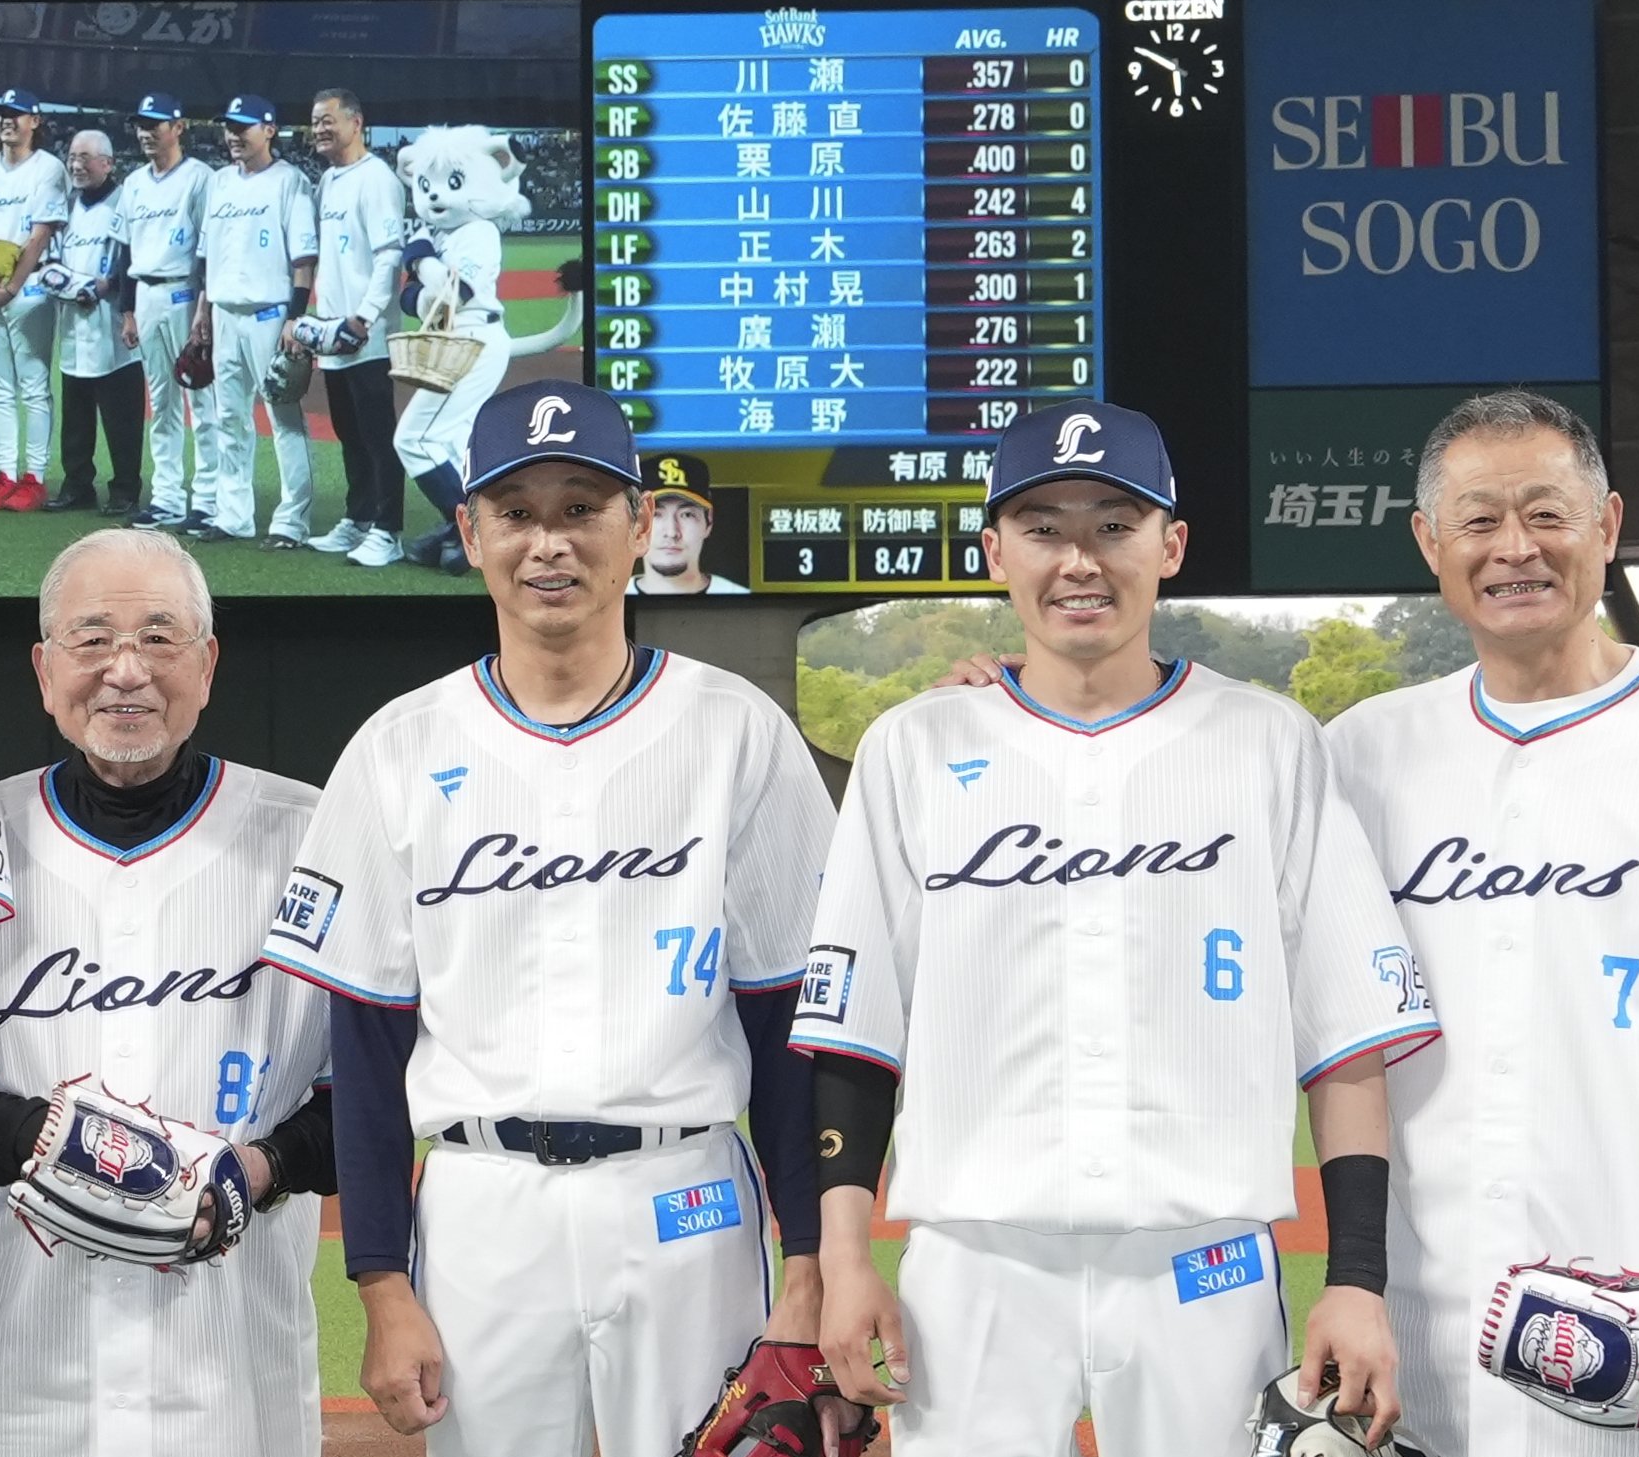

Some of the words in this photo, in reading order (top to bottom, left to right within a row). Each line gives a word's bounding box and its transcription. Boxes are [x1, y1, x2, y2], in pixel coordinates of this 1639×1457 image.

[764, 7, 818, 25] SoftBank
[1166, 22, 1185, 41] 12
[759, 23, 826, 48] HAWKS
[955, 27, 1008, 50] AVG.
[1047, 29, 1079, 45] HR
[609, 65, 637, 94] SS
[967, 60, 1014, 88] .357
[609, 107, 636, 136] RF
[718, 101, 862, 137] 佐藤直
[967, 103, 1015, 131] .278
[1169, 98, 1184, 118] 6
[1273, 91, 1568, 171] SEIBU
[609, 150, 639, 179] 3B
[737, 142, 844, 178] 栗原
[968, 145, 1015, 173] .400
[609, 193, 639, 222] DH
[738, 186, 843, 221] 山川
[968, 188, 1015, 215] .242
[611, 235, 637, 264] LF
[738, 228, 844, 263] 正木
[968, 231, 1016, 258] .263
[1302, 198, 1540, 276] SOGO
[613, 277, 640, 306] 1B
[720, 271, 863, 306] 中村晃
[969, 274, 1016, 301] .300
[610, 319, 640, 349] 2B
[969, 317, 1017, 344] .276
[611, 361, 638, 390] CF
[719, 354, 864, 390] 牧原大
[970, 358, 1017, 386] .222
[739, 398, 846, 433] 海野
[889, 451, 947, 482] 有原
[962, 450, 996, 480] 航
[770, 508, 842, 533] 登板数
[863, 508, 936, 533] 防御率
[959, 507, 984, 532] 勝
[799, 548, 813, 575] 3
[875, 547, 923, 574] 8.47
[964, 546, 980, 574] 0
[415, 833, 703, 906] Lions
[925, 824, 1235, 892] Lions
[654, 925, 722, 998] 74
[1203, 927, 1243, 1001] 6
[667, 1184, 723, 1212] SEIBU
[677, 1209, 723, 1233] SOGO
[1186, 1240, 1247, 1272] SEIBU
[1196, 1265, 1246, 1294] SOGO
